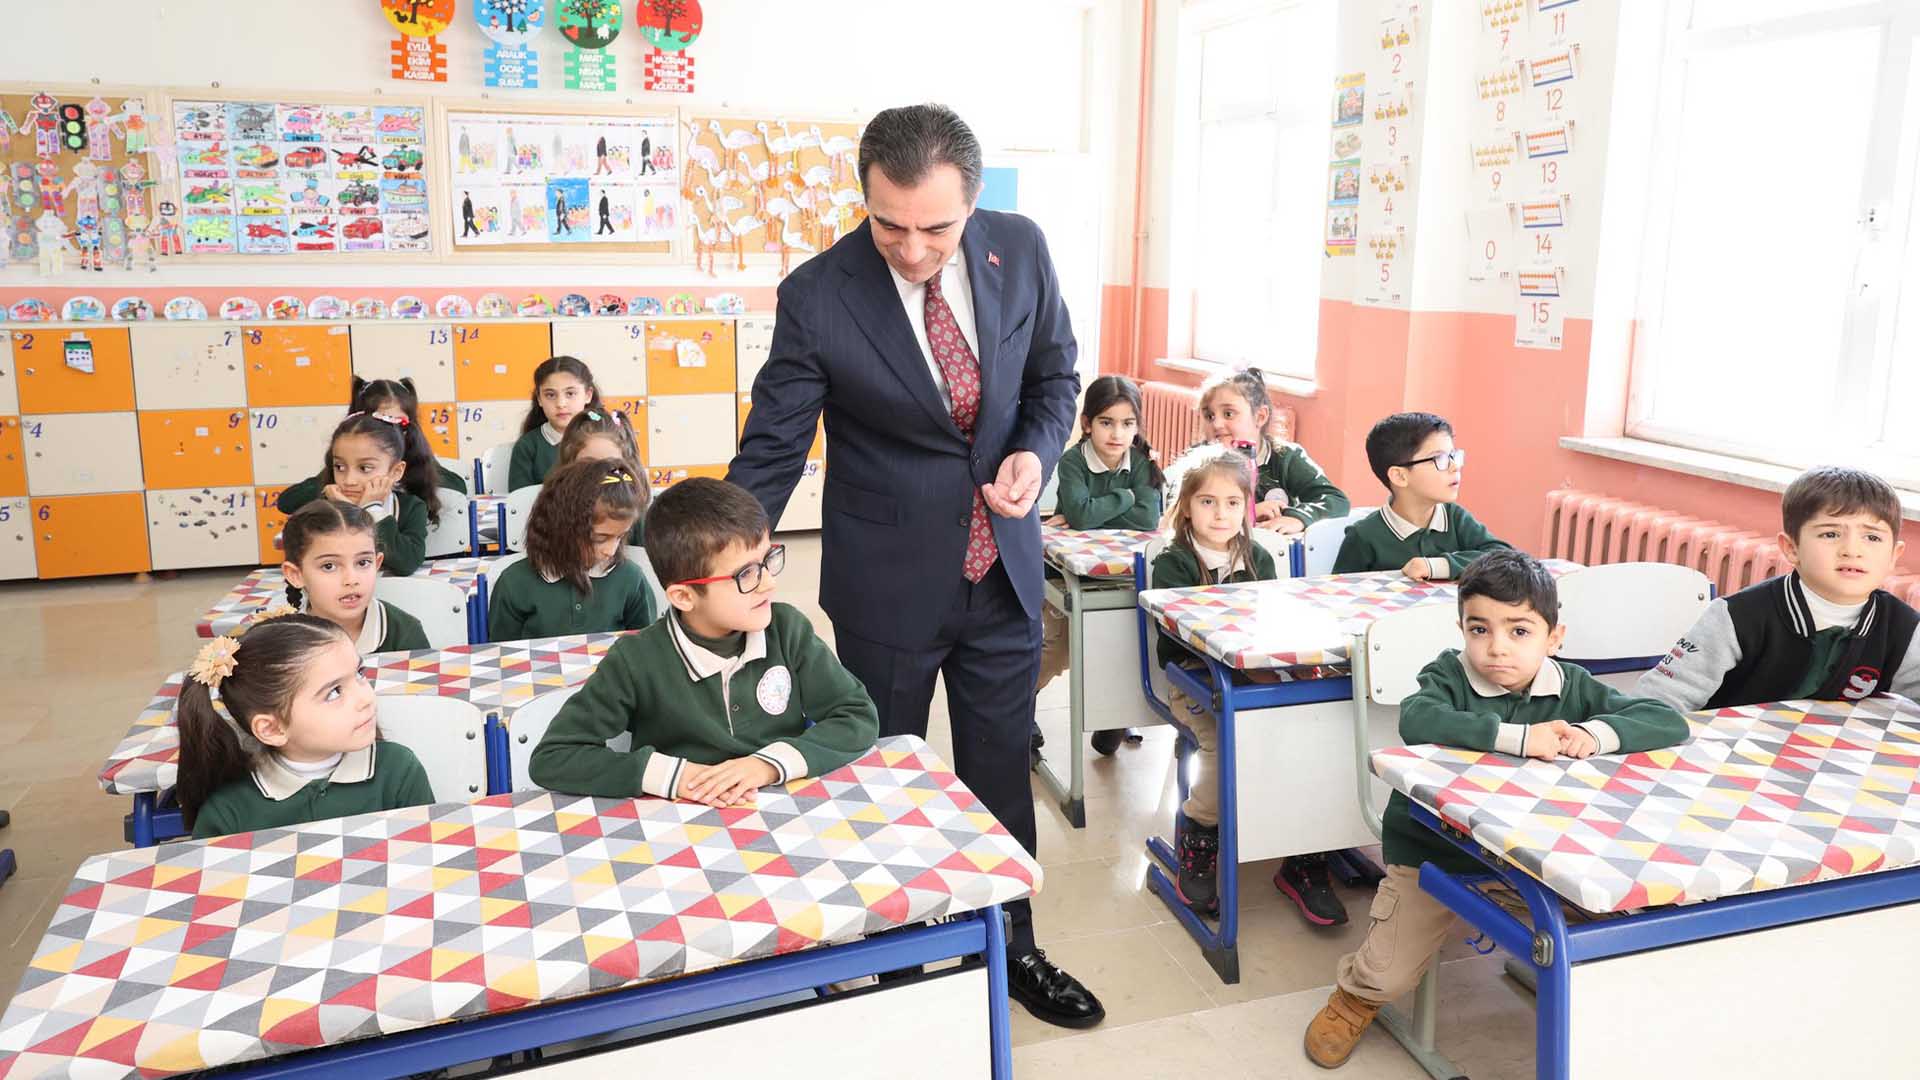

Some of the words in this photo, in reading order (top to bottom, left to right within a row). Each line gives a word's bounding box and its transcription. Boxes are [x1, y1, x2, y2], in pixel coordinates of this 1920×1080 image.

[1554, 12, 1565, 35] 11
[1500, 30, 1509, 50] 7
[496, 50, 527, 60] ARALIK
[579, 54, 604, 63] MART
[499, 64, 525, 74] OCAK
[1392, 53, 1402, 74] 2
[404, 70, 435, 80] KASIM
[1546, 88, 1563, 111] 12
[1497, 101, 1505, 122] 8
[1388, 126, 1397, 147] 3
[1542, 161, 1557, 184] 13
[1492, 171, 1501, 191] 9
[1384, 197, 1393, 216] 4
[1486, 240, 1495, 260] 0
[1536, 233, 1553, 254] 14
[1380, 263, 1390, 282] 5
[1532, 302, 1549, 323] 15
[22, 334, 34, 350] 2
[224, 331, 232, 346] 7
[251, 329, 262, 344] 8
[430, 328, 448, 344] 13
[460, 328, 479, 343] 14
[464, 408, 483, 422] 16
[623, 400, 640, 415] 21
[228, 413, 240, 428] 9
[256, 413, 277, 429] 10
[431, 409, 449, 424] 15
[30, 422, 42, 438] 4
[652, 471, 672, 484] 24
[228, 493, 246, 508] 11
[0, 505, 10, 521] 5
[38, 505, 50, 521] 6
